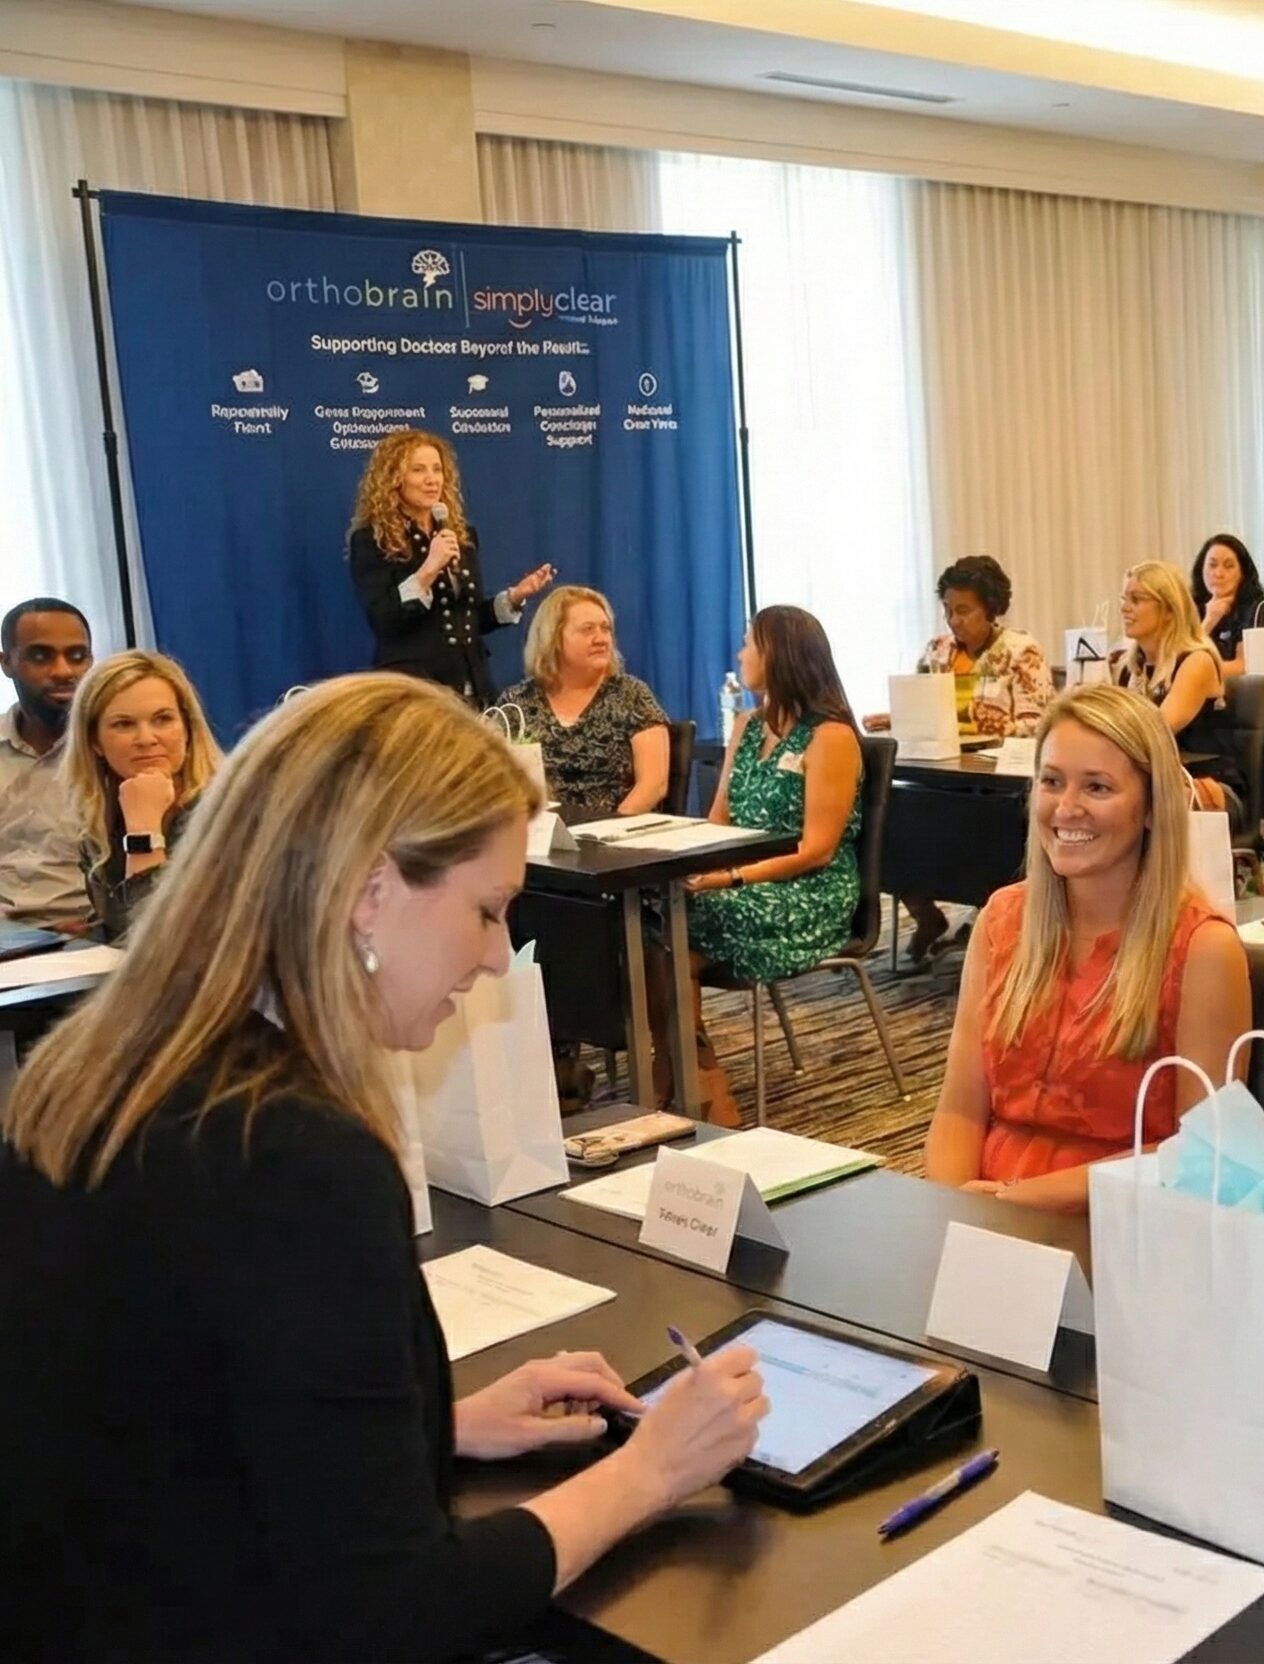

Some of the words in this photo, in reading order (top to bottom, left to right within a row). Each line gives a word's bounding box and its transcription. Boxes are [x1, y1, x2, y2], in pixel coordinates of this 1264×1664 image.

[267, 276, 453, 309] orthobrain
[473, 286, 617, 317] simplyclear
[311, 334, 397, 355] Supporting
